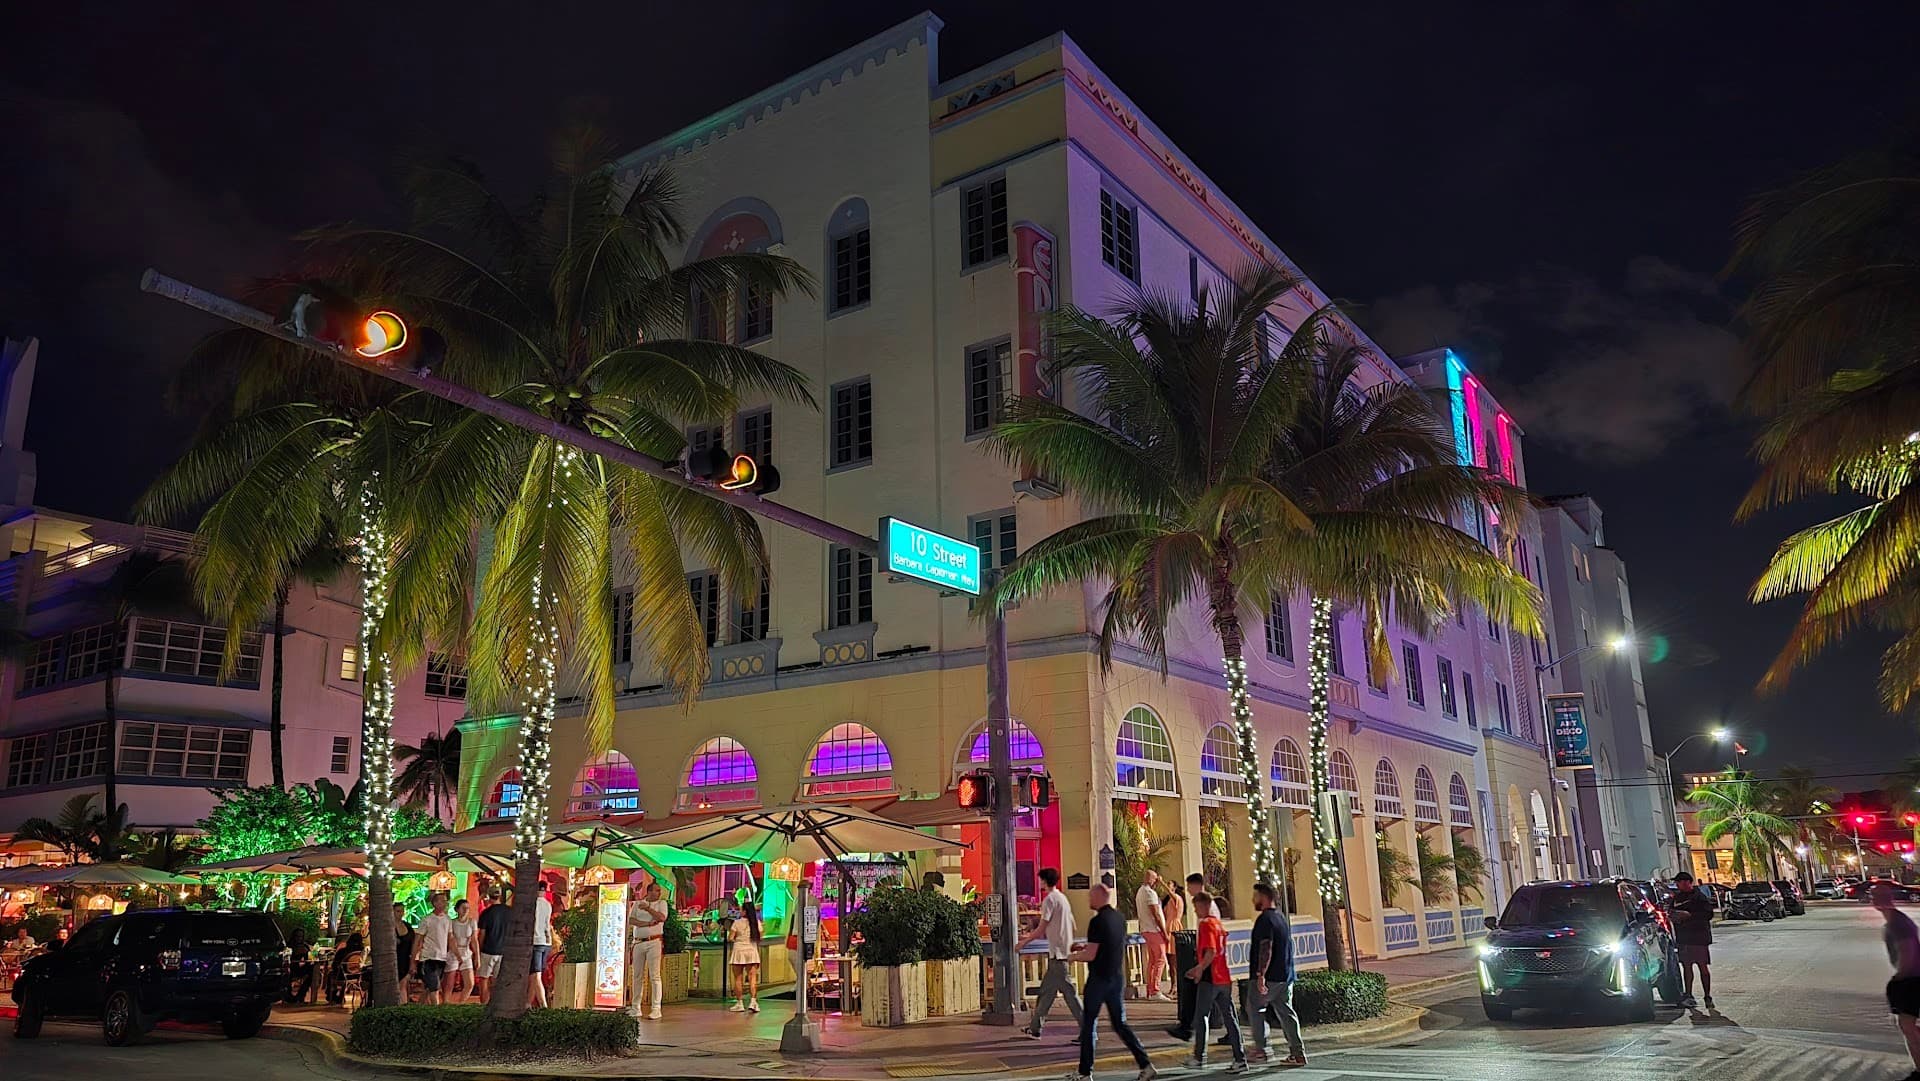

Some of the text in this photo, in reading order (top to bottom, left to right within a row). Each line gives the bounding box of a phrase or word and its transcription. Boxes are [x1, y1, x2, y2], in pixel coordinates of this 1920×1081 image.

[911, 531, 967, 569] 10 Street
[1556, 727, 1583, 736] DECO
